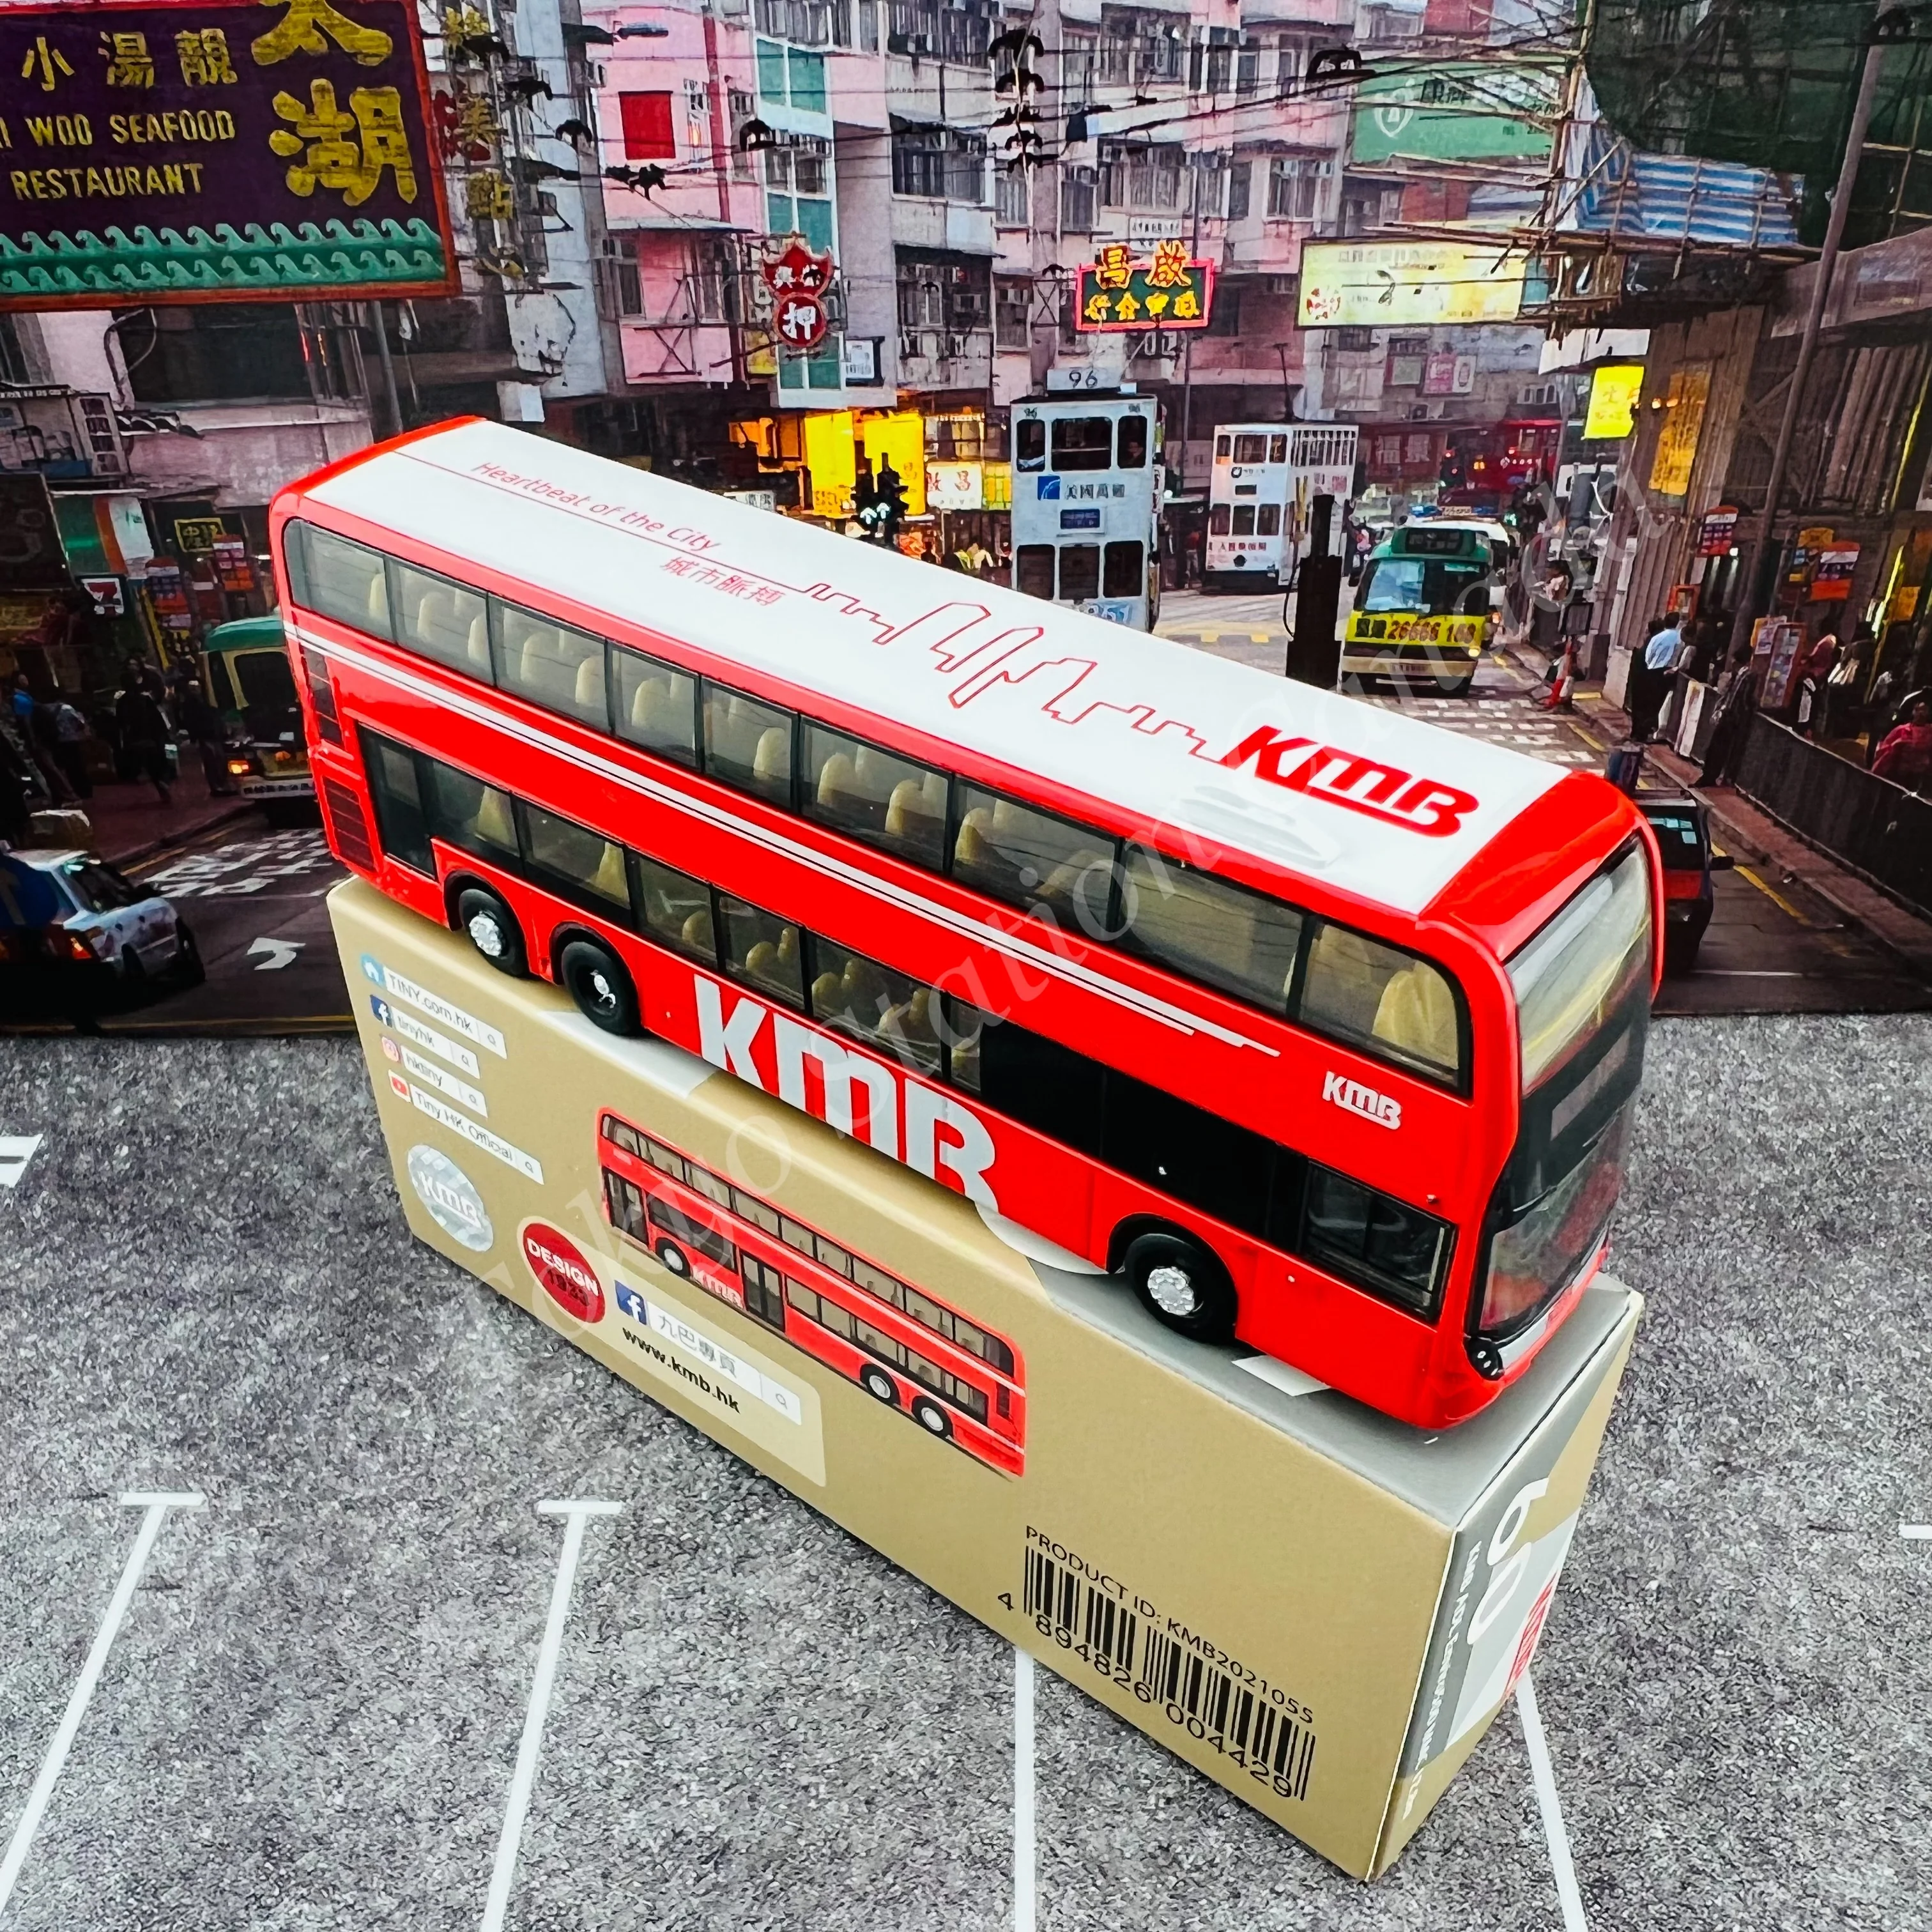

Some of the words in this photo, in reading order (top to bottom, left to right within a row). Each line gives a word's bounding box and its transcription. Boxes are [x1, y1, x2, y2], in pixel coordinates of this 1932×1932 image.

[24, 114, 93, 146] WOO
[110, 109, 235, 144] SEAFOOD
[10, 163, 204, 201] RESTAURANT
[1069, 369, 1098, 388] 96
[471, 462, 592, 507] Heartbeat
[589, 501, 625, 516] of
[620, 511, 665, 532] the
[667, 527, 722, 552] City
[660, 556, 786, 606] 城市脈搏
[1220, 724, 1480, 838] KMB
[388, 973, 473, 1034] TINY.com.hk
[694, 974, 999, 1214] KMB
[1322, 1070, 1402, 1130] KMB
[417, 1170, 484, 1231] KMB
[526, 1238, 599, 1297] DESIGN
[622, 1327, 741, 1414] www.kmb.hk
[1025, 1525, 1128, 1600] PRODUCT
[1467, 1477, 1549, 1646] 60
[997, 1592, 1015, 1611] 4
